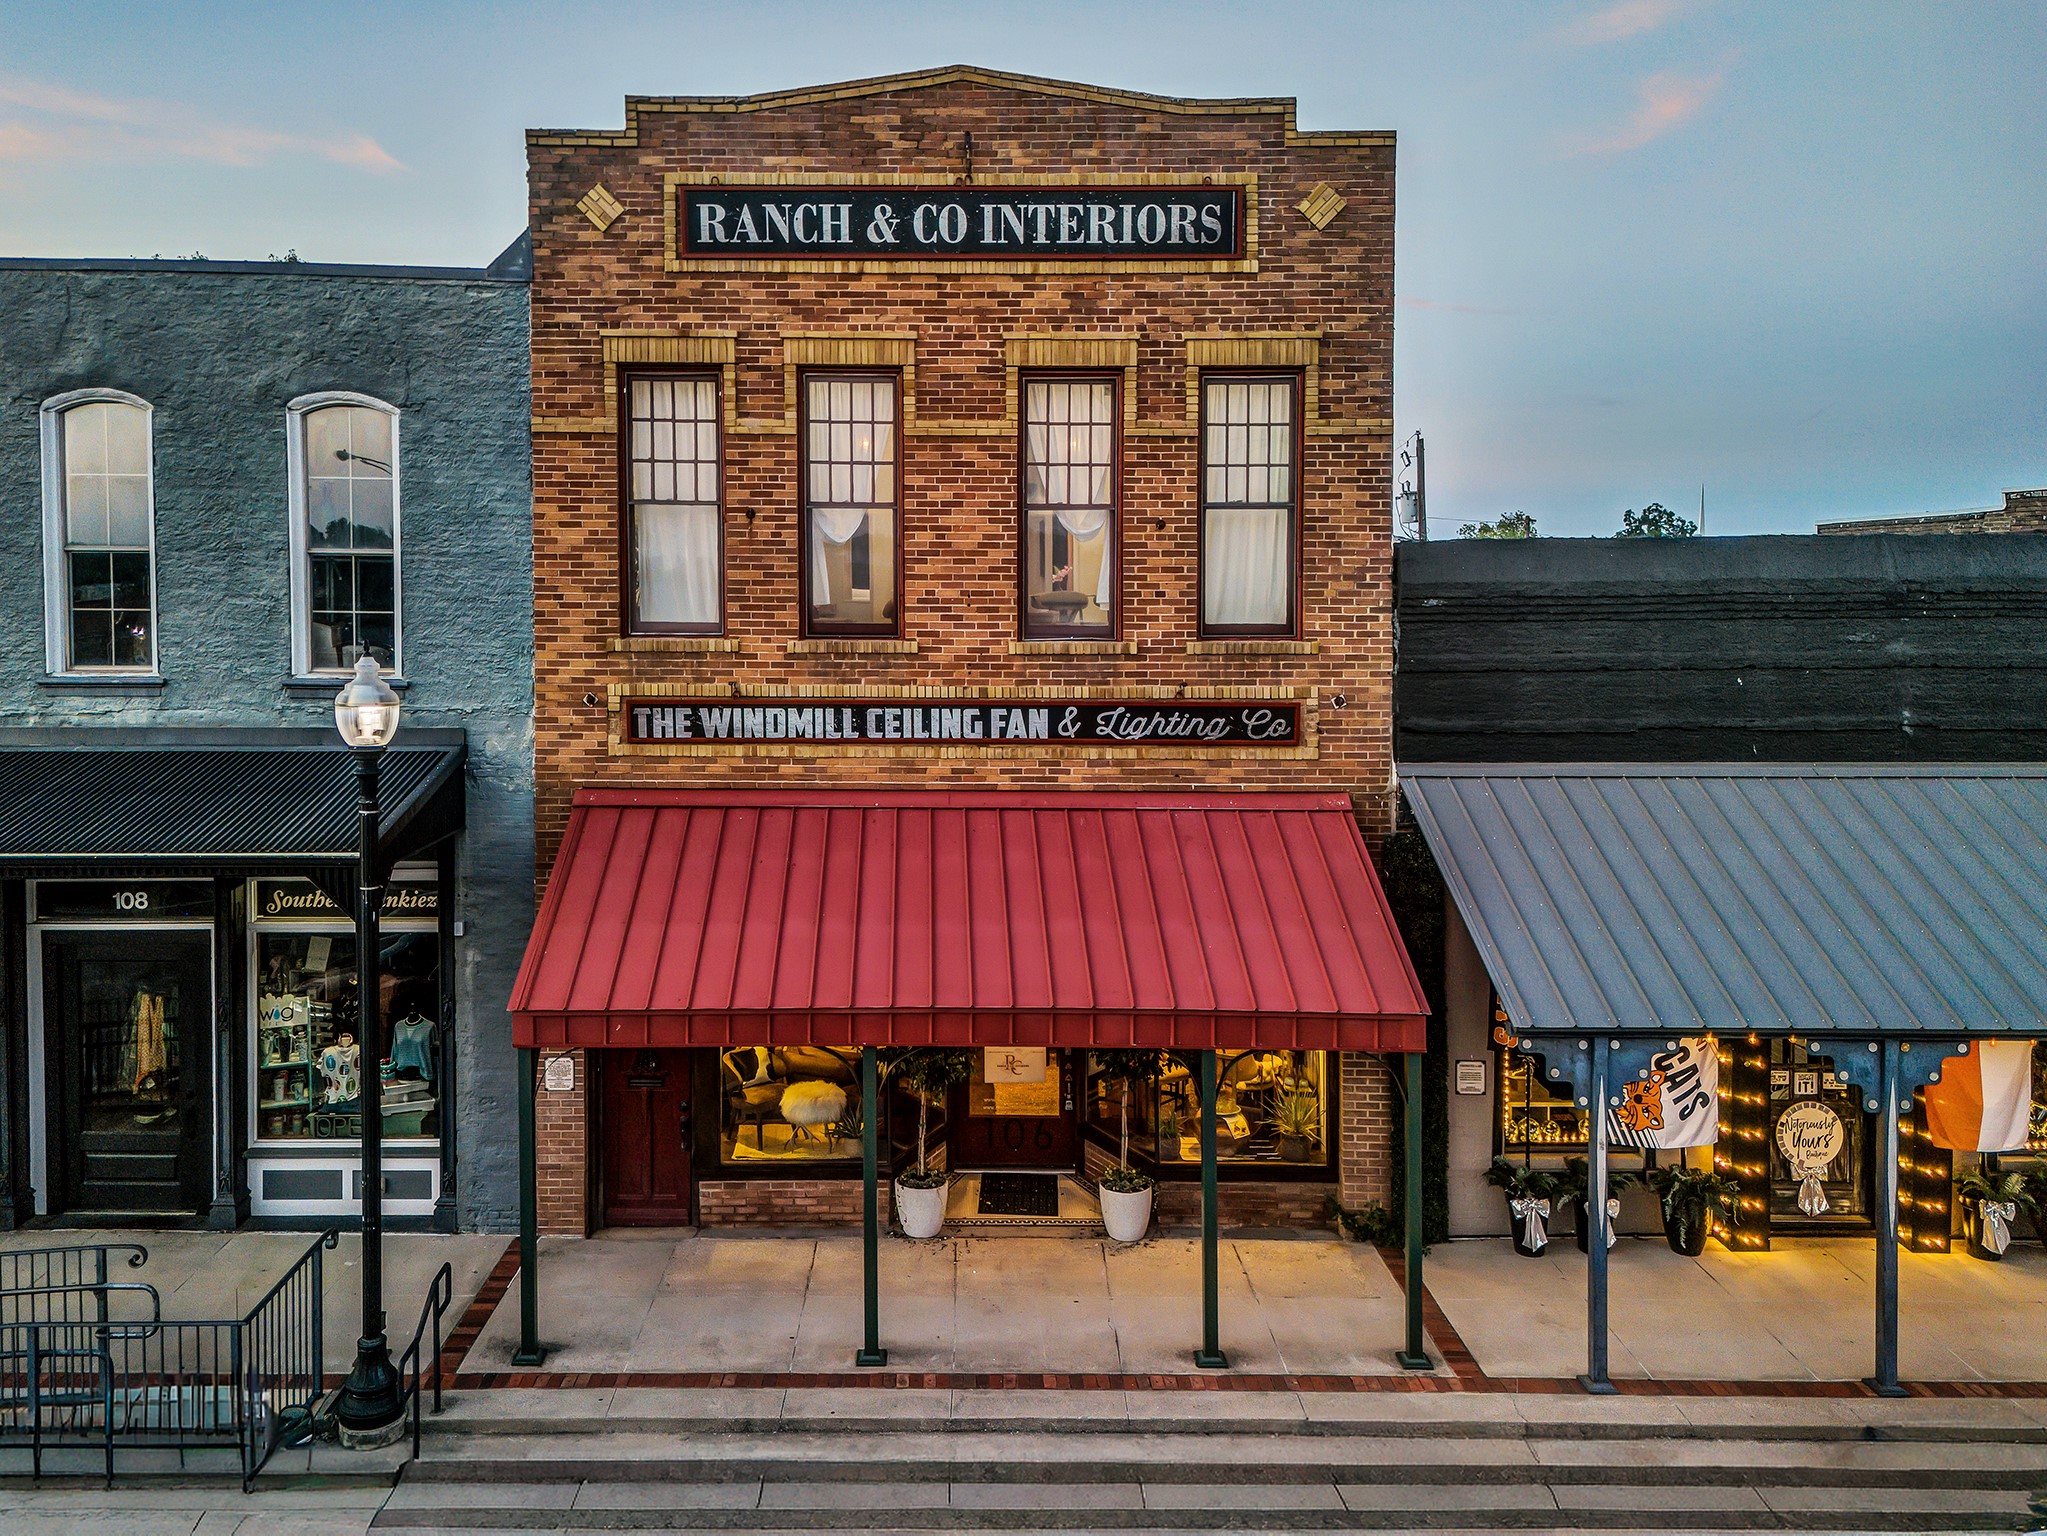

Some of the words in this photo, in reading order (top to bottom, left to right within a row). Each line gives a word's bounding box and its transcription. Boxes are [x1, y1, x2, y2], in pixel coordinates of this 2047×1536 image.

[696, 203, 854, 244] RANCH
[866, 203, 901, 244] &
[913, 203, 968, 244] CO
[979, 203, 1222, 245] INTERIORS
[633, 707, 693, 739] THE
[702, 708, 860, 739] WINDMILL
[866, 708, 983, 739] CEILING
[990, 708, 1049, 740] FAN
[1057, 706, 1080, 739] &
[1096, 706, 1230, 741] Lighting
[1241, 708, 1291, 740] Co
[112, 891, 149, 910] 108
[266, 889, 339, 914] Southe
[381, 889, 438, 908] nkiez
[259, 1005, 294, 1022] wig
[1653, 1045, 1711, 1121] CATS
[316, 1117, 362, 1138] OPE
[1784, 1116, 1838, 1136] Notoriously
[1792, 1129, 1835, 1160] Yours
